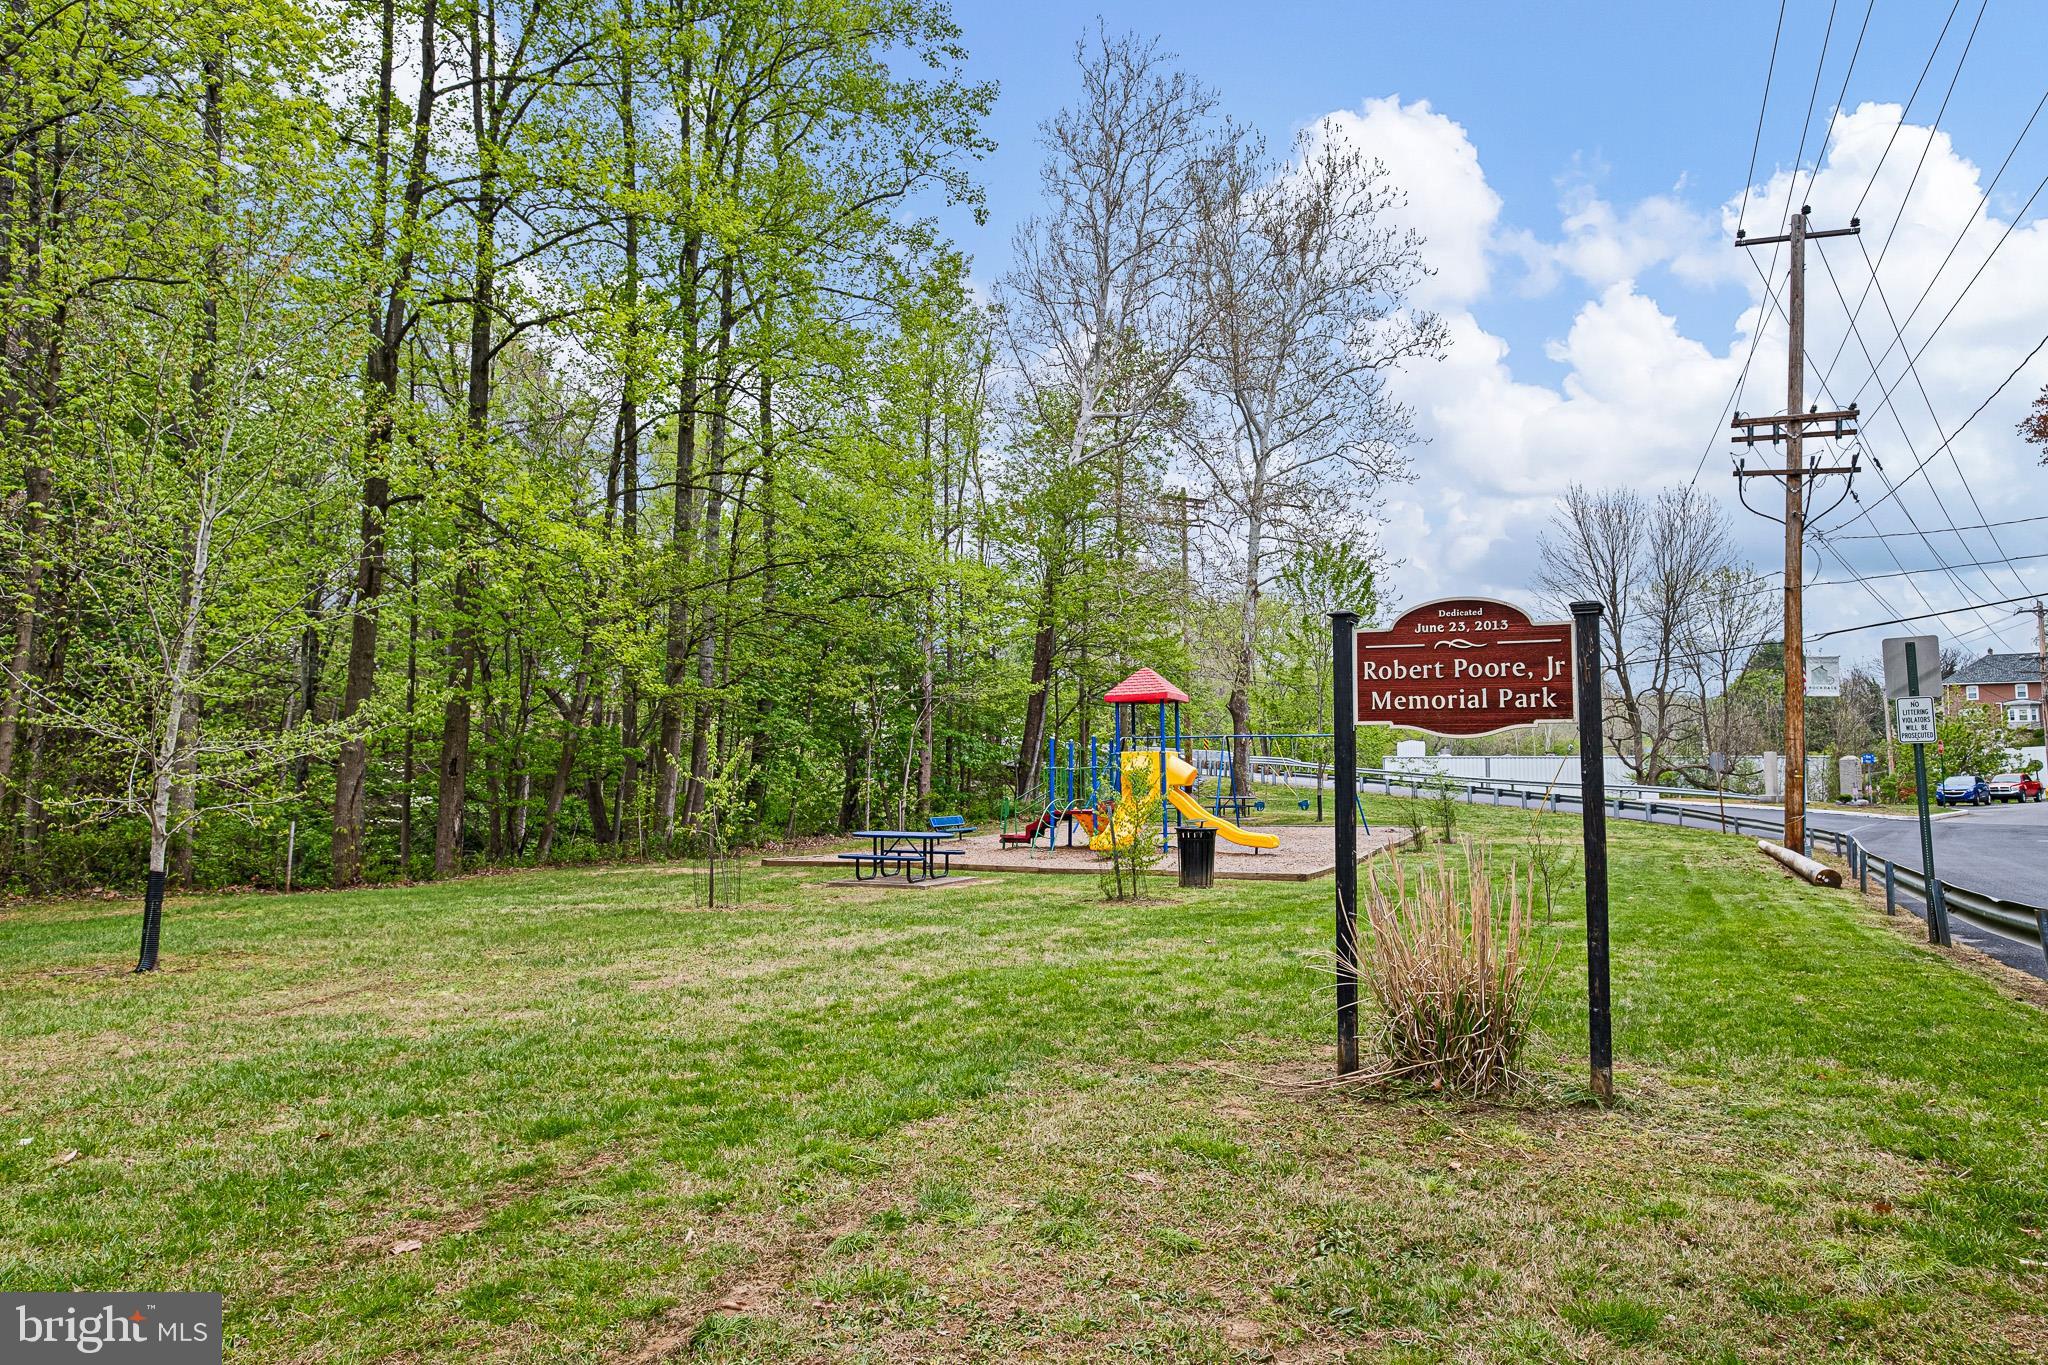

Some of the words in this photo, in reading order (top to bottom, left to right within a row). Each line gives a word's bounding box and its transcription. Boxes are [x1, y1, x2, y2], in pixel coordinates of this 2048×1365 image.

[1438, 608, 1483, 617] Dedicated
[1414, 623, 1445, 633] June
[1449, 622, 1470, 632] 23,
[1475, 620, 1508, 631] 2013
[1363, 660, 1444, 680] Robert
[1454, 659, 1533, 679] Poore,
[1543, 656, 1565, 681] Jr
[1371, 688, 1488, 710] Memorial
[1498, 687, 1558, 708] Park
